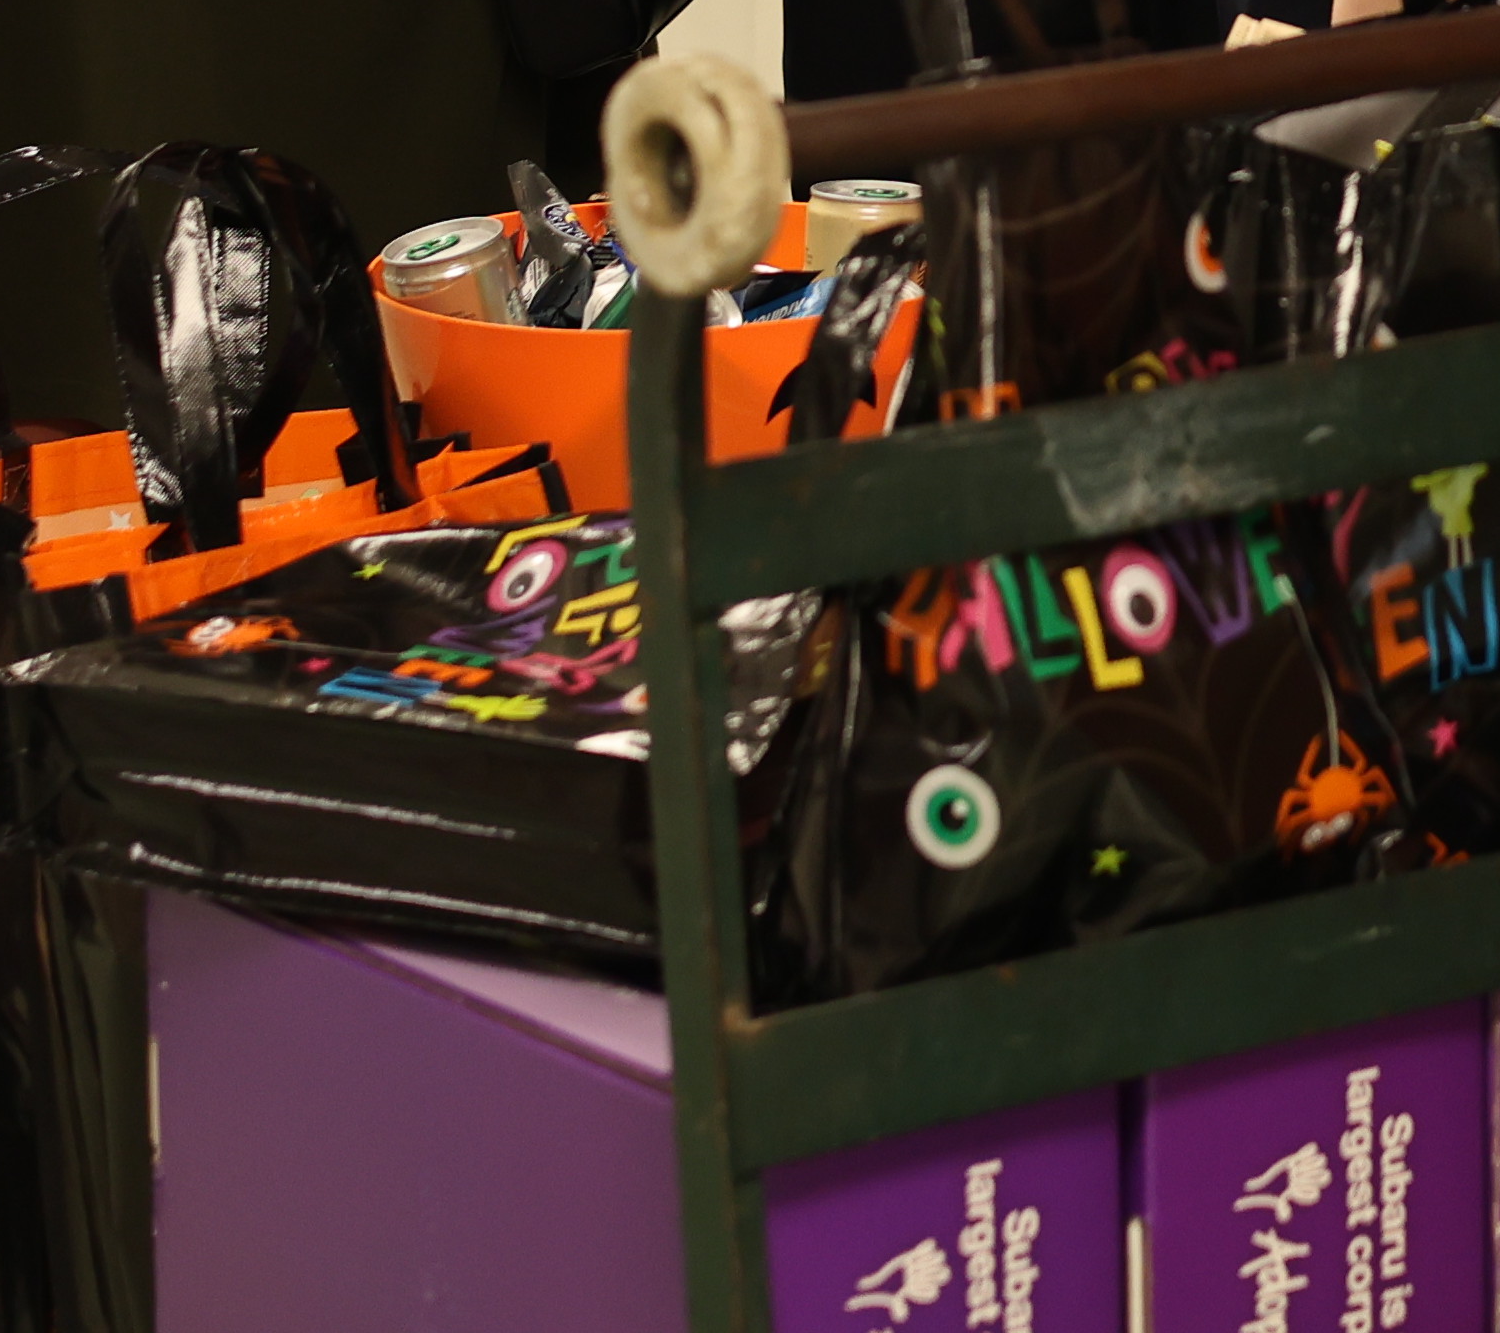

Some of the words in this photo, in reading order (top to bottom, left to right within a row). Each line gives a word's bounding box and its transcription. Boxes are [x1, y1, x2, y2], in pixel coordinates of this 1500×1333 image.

[1338, 1066, 1380, 1230] largest
[1379, 1113, 1415, 1278] Subaru
[958, 1159, 1003, 1329] largest
[1379, 1283, 1415, 1329] is
